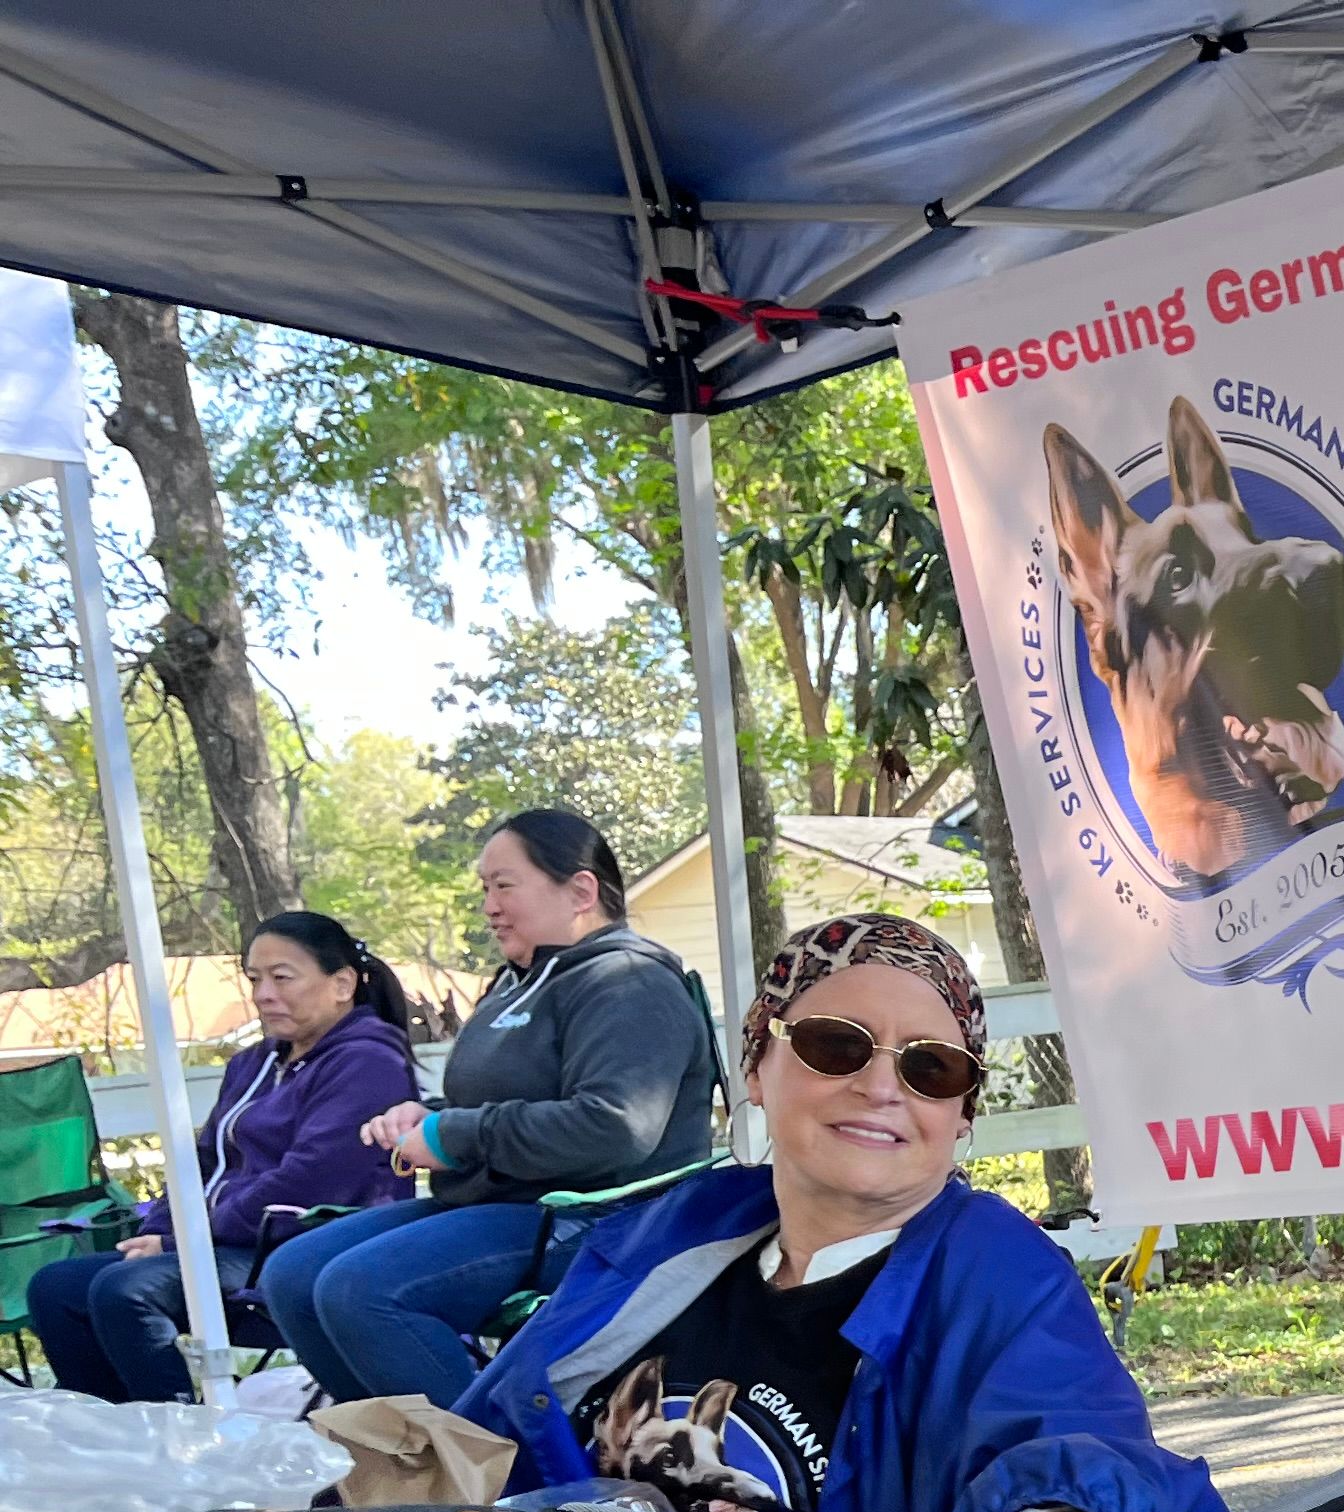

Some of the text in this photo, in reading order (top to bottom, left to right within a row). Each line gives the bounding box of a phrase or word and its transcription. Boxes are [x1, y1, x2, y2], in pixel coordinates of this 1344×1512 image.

[949, 286, 1196, 399] Rescuing
[1021, 600, 1113, 878] K9 SERVICES
[1215, 898, 1267, 943] Est.
[748, 1382, 824, 1458] GERMAN
